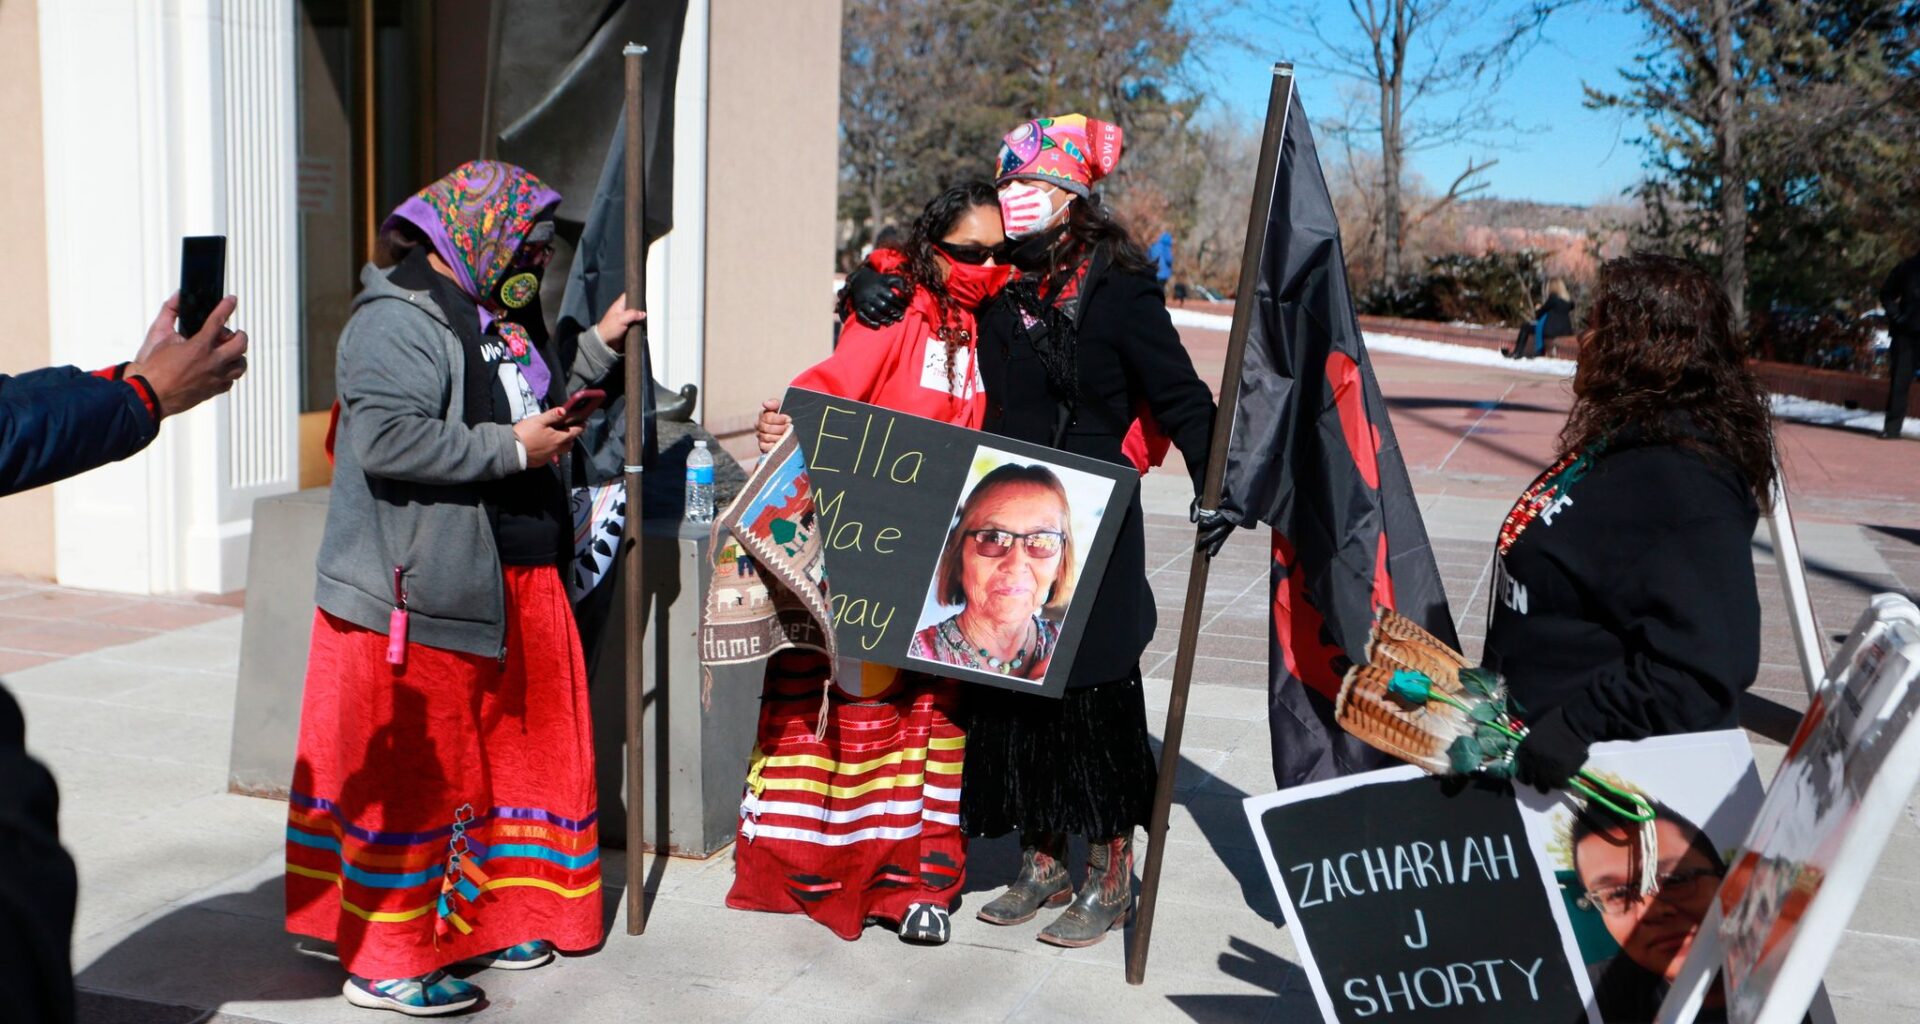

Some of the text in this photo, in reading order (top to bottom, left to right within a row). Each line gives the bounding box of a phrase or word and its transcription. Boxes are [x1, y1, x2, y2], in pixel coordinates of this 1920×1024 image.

[810, 405, 923, 483] Ella
[813, 488, 902, 554] Mae
[703, 627, 760, 659] Home
[1291, 834, 1519, 908] ZACHARIAH
[1404, 908, 1428, 949] J
[1344, 957, 1543, 1017] SHORTY
